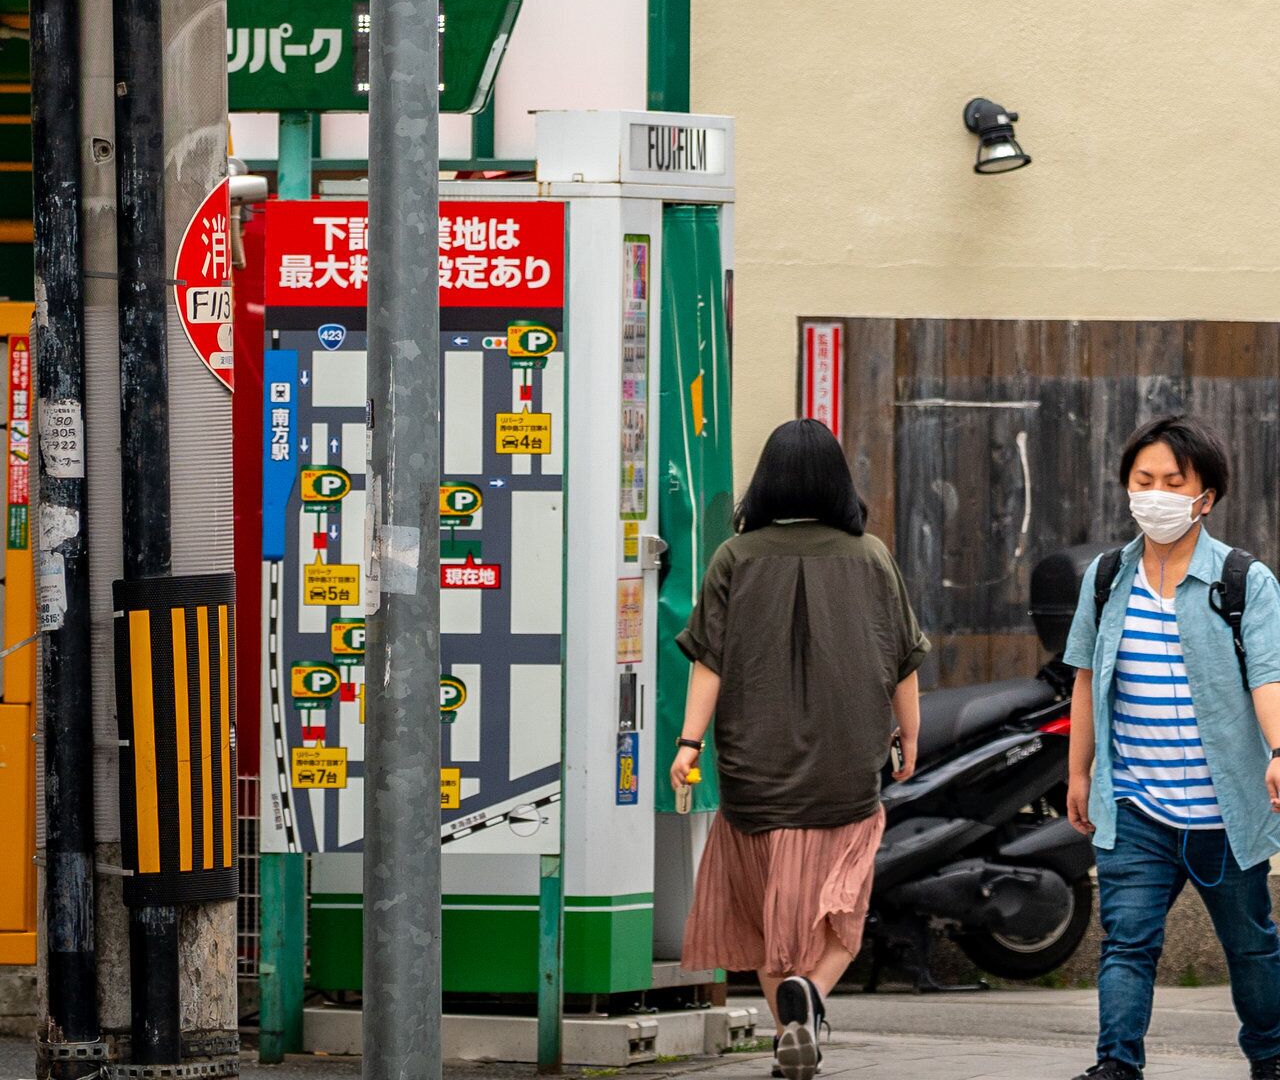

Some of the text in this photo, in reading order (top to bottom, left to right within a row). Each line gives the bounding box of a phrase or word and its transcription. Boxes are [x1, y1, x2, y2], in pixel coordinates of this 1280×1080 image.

[647, 126, 708, 171] FUJIFILM
[321, 330, 342, 340] 423
[528, 332, 548, 351] P
[271, 408, 290, 462] 南方駅
[520, 435, 542, 449] 4台
[321, 476, 342, 495] P
[454, 492, 475, 510] P
[445, 568, 496, 586] 現在地
[328, 586, 350, 601] 5台
[312, 672, 332, 691] P
[317, 770, 337, 784] 7台
